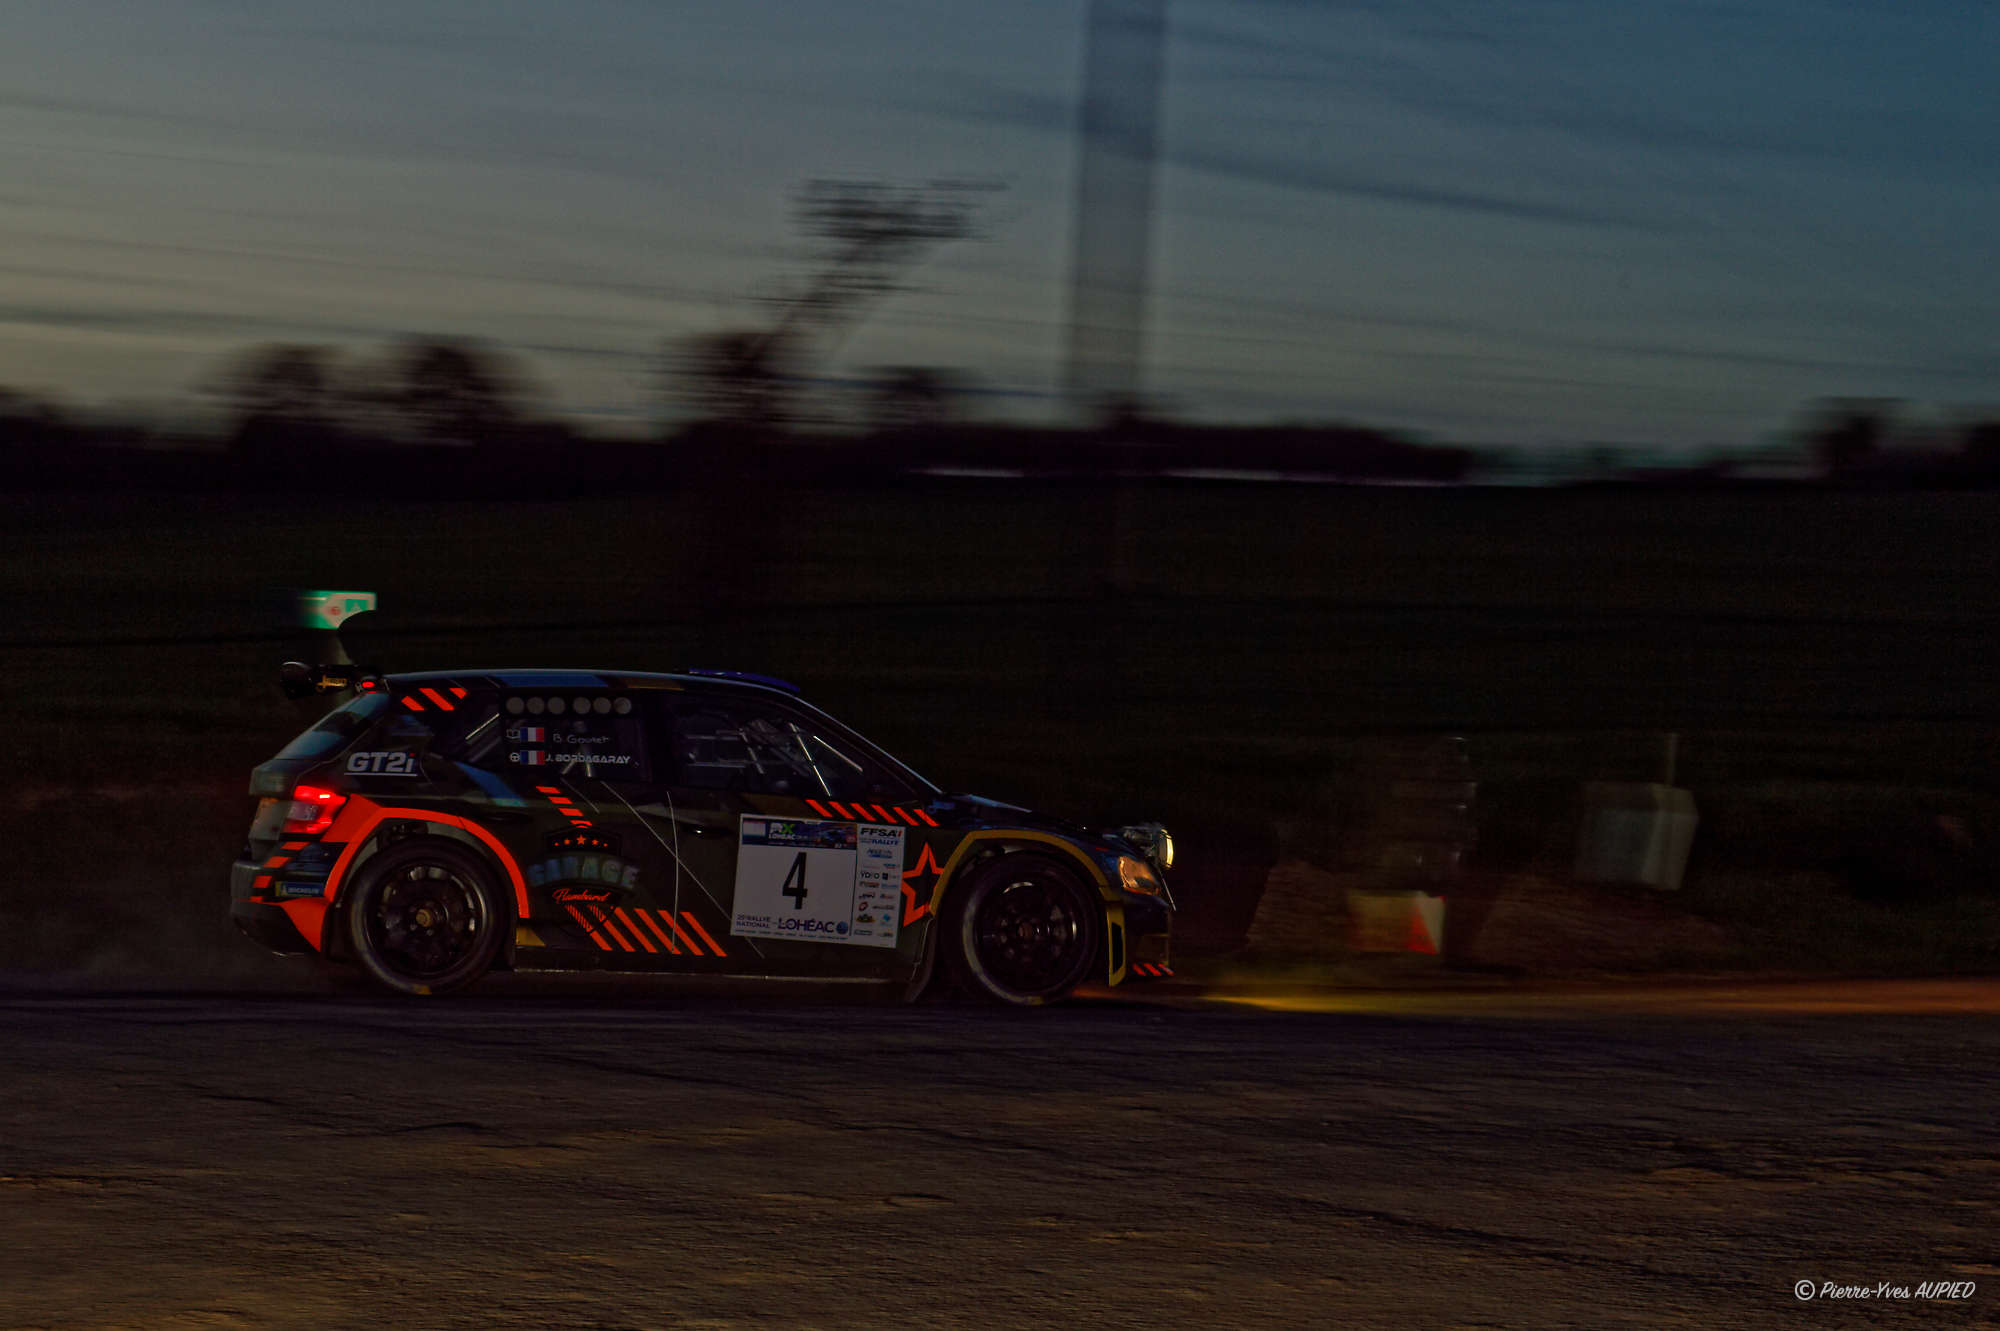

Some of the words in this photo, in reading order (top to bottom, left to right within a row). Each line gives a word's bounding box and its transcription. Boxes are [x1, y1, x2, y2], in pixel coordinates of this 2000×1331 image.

[346, 751, 416, 773] GT2i
[860, 827, 899, 838] FFSA
[782, 852, 808, 910] 4
[777, 917, 834, 933] LOHÉAC
